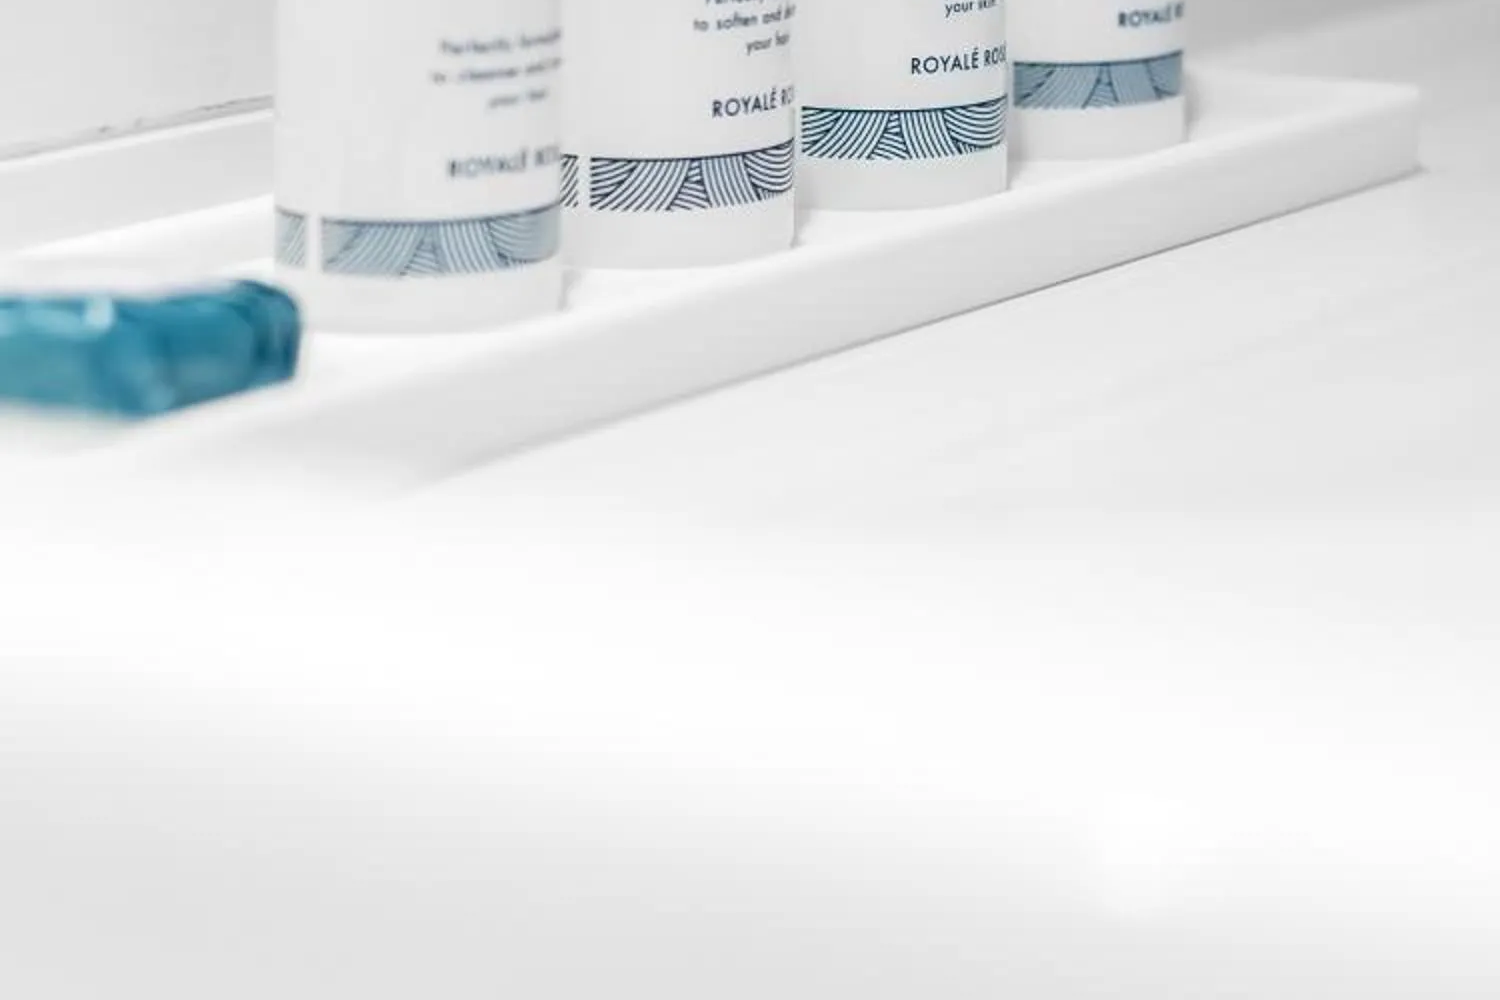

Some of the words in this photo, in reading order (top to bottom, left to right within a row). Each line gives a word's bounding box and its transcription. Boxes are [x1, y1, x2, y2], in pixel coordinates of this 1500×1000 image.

[945, 0, 974, 18] your
[693, 18, 709, 31] to
[716, 12, 758, 30] soften
[911, 46, 978, 75] ROYALÉ
[712, 86, 776, 118] ROYALÉ
